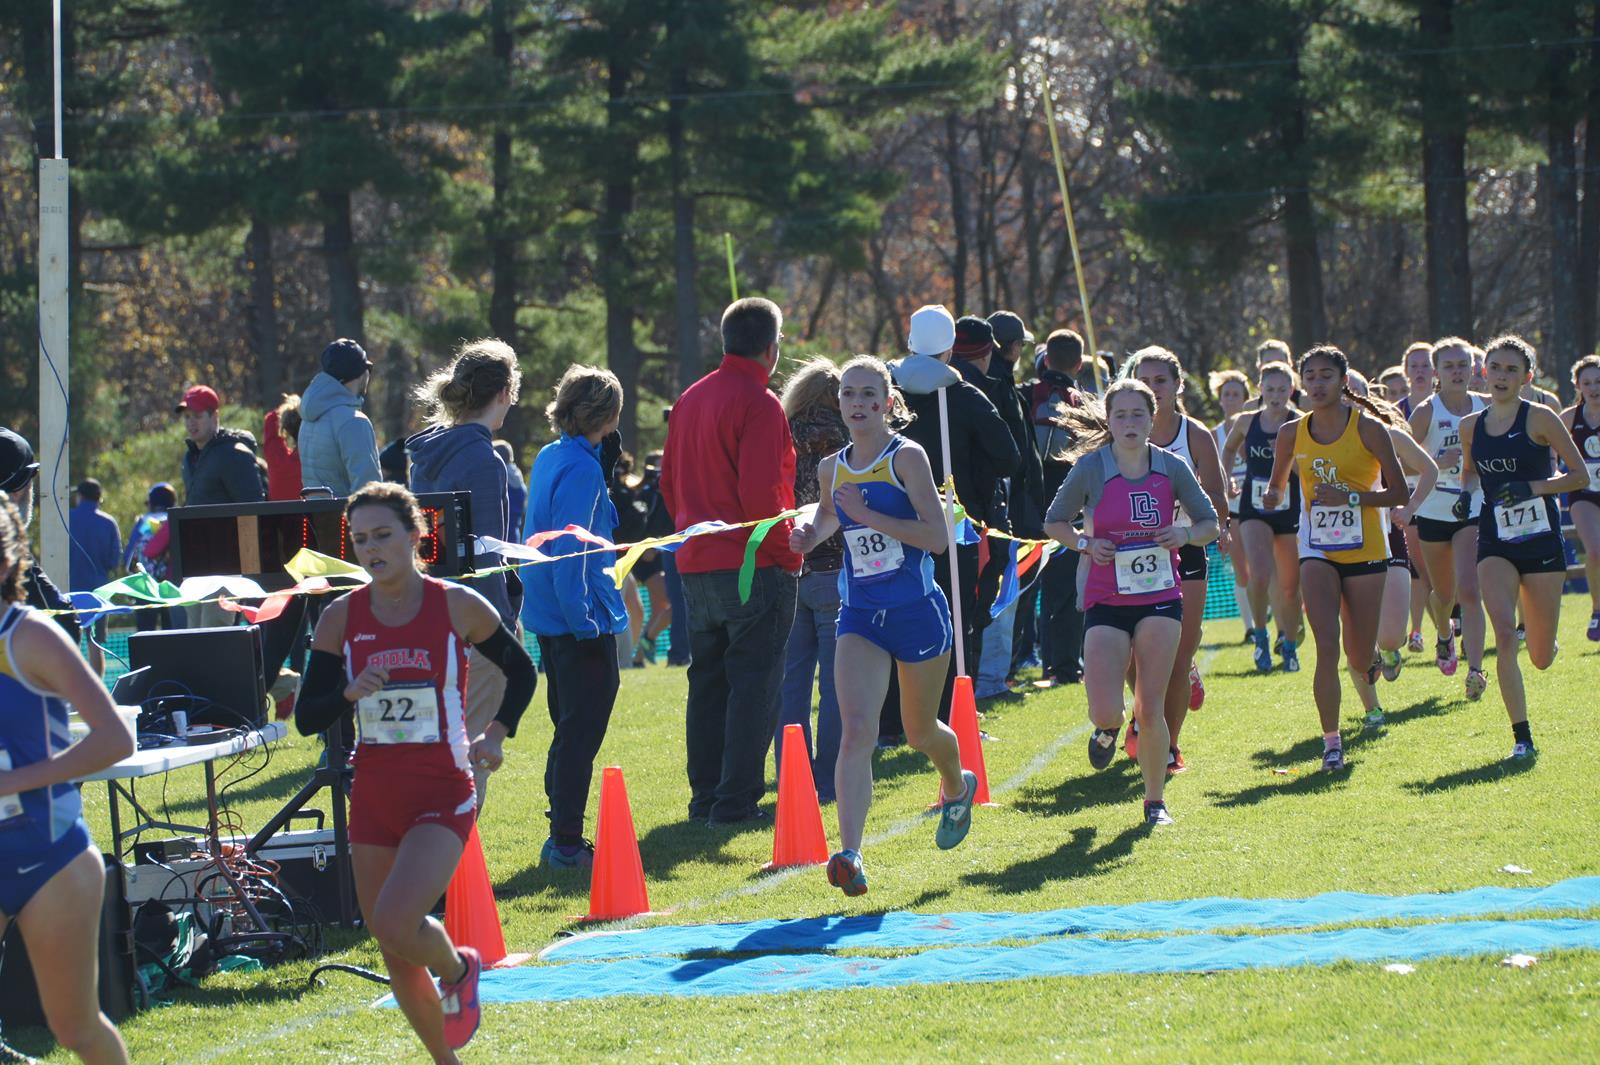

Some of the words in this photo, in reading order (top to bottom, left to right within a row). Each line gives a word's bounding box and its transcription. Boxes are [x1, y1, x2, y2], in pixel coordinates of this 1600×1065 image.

[1250, 446, 1273, 459] NC
[1476, 458, 1517, 474] NCU
[1316, 510, 1354, 528] 278
[1501, 505, 1540, 528] 171
[857, 533, 886, 555] 38
[1131, 554, 1157, 574] 63
[379, 697, 416, 722] 22
